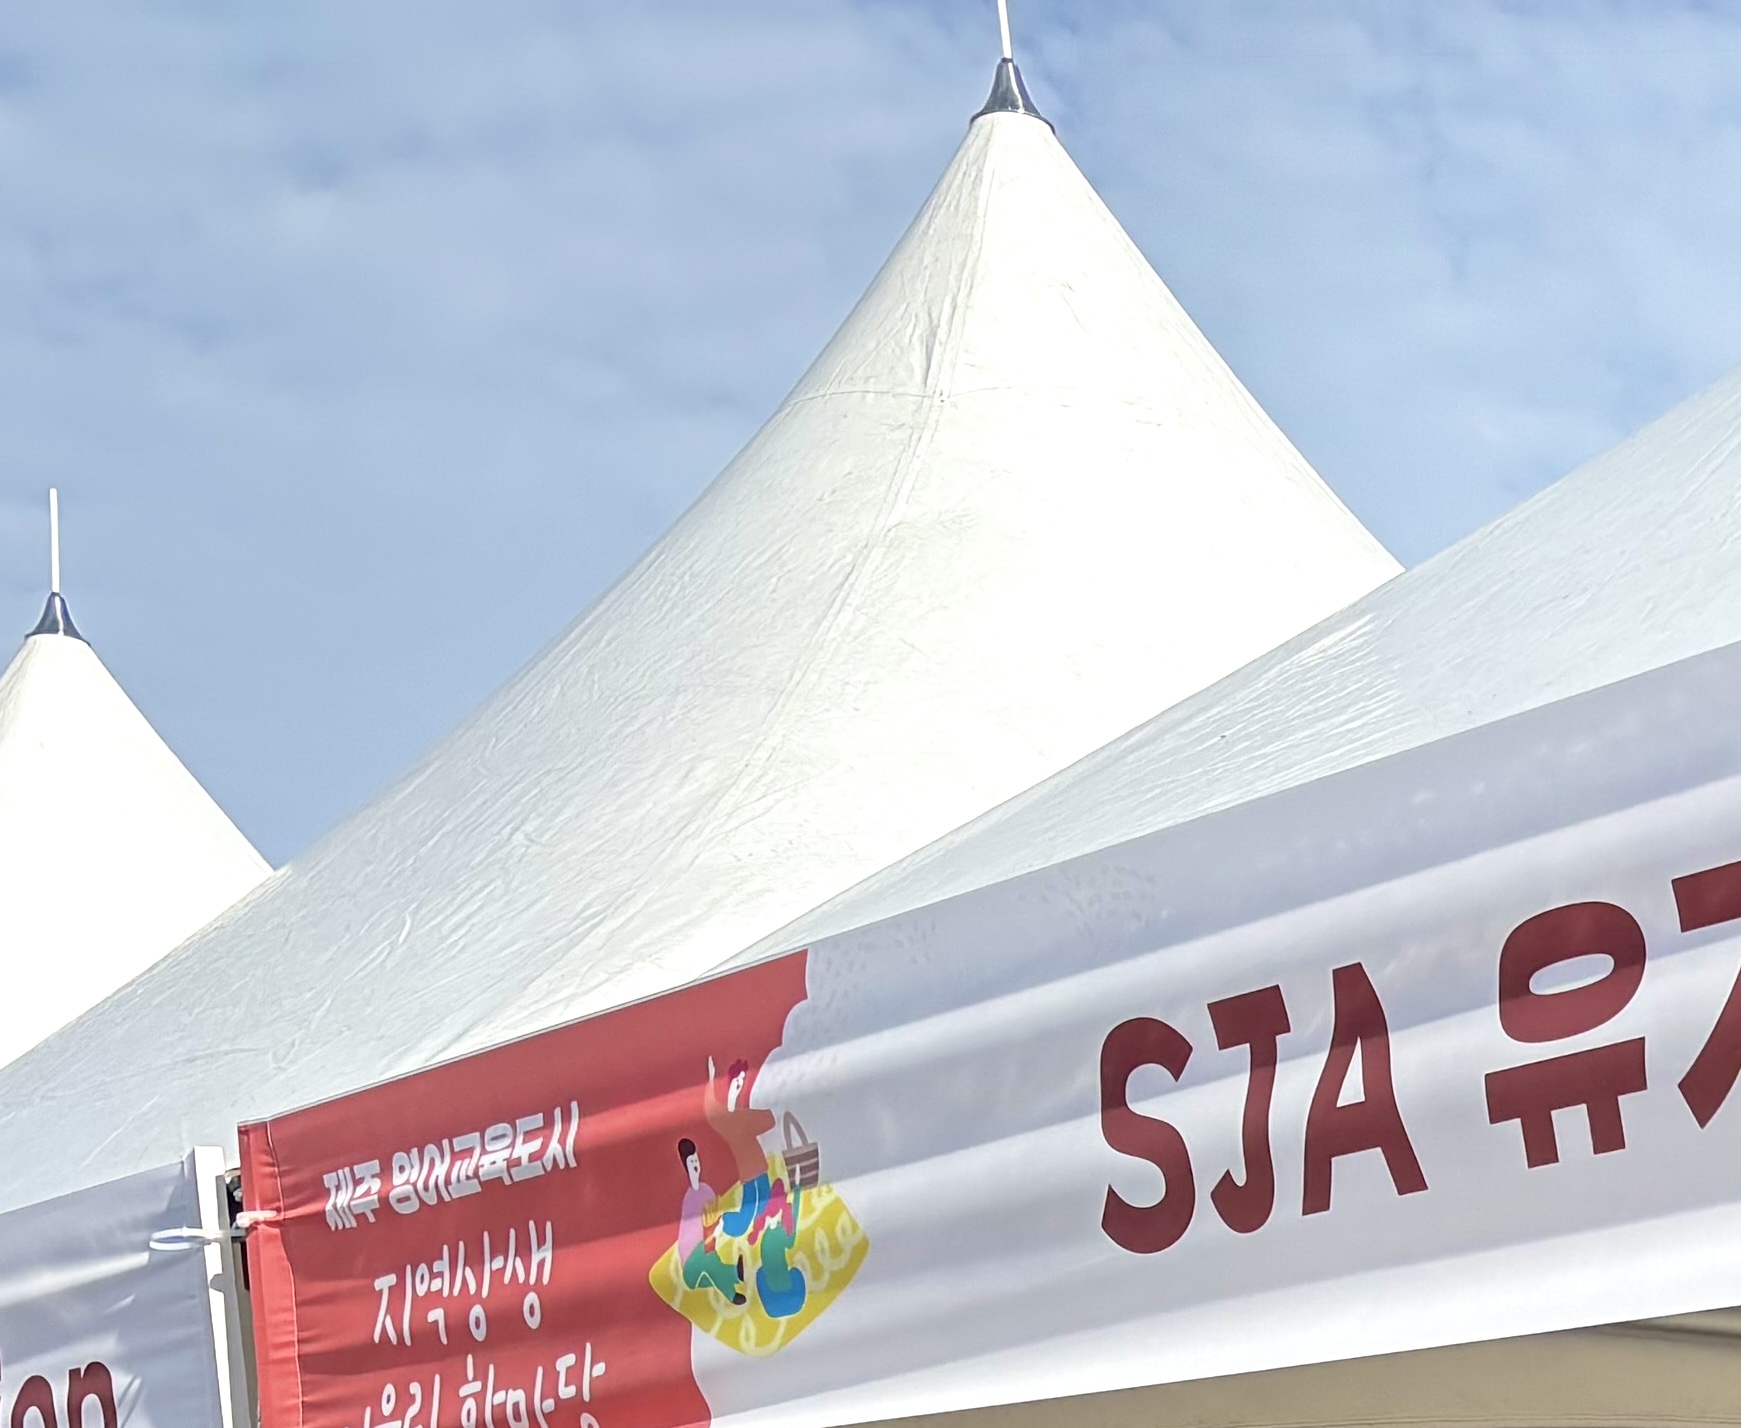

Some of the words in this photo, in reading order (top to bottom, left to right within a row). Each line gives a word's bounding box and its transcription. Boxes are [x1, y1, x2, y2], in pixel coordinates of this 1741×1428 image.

[322, 1159, 381, 1231] 제주
[388, 1100, 580, 1215] 영어교육도시
[1101, 963, 1428, 1254] SJA
[373, 1219, 553, 1347] 지역상생
